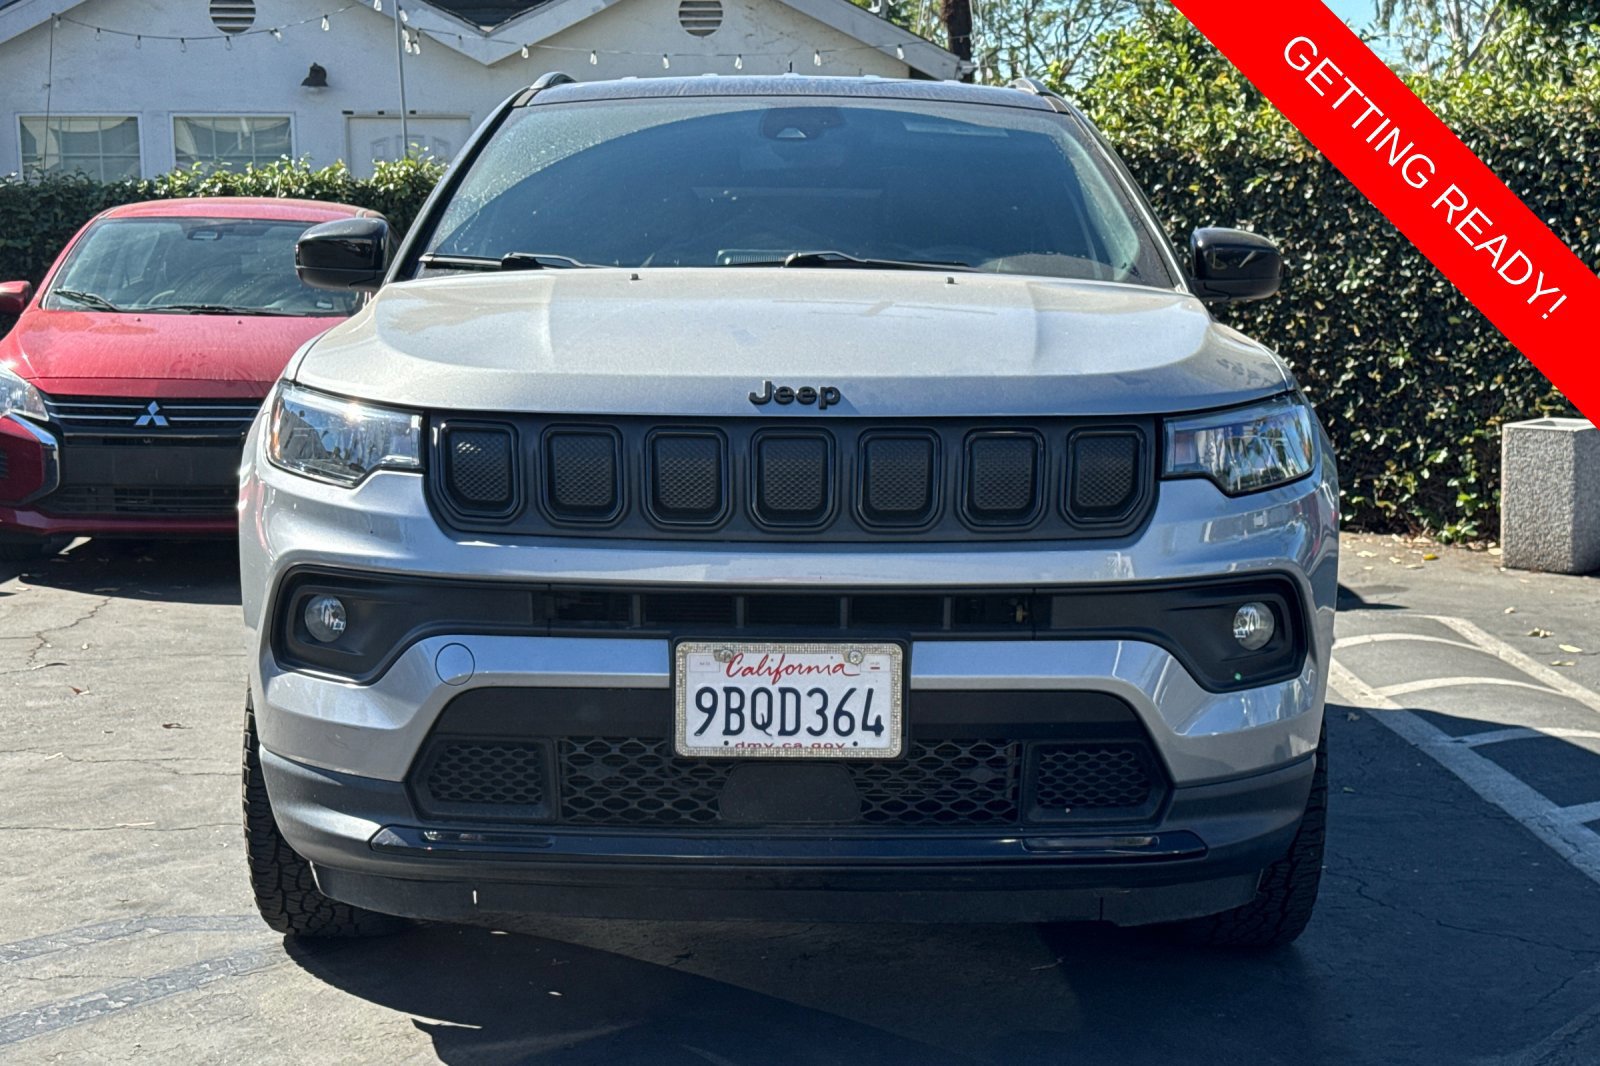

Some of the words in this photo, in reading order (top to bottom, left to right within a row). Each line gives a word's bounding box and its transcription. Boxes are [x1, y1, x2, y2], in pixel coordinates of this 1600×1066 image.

[748, 380, 841, 410] Jeep
[726, 653, 861, 685] California
[694, 686, 885, 737] 9BQD364
